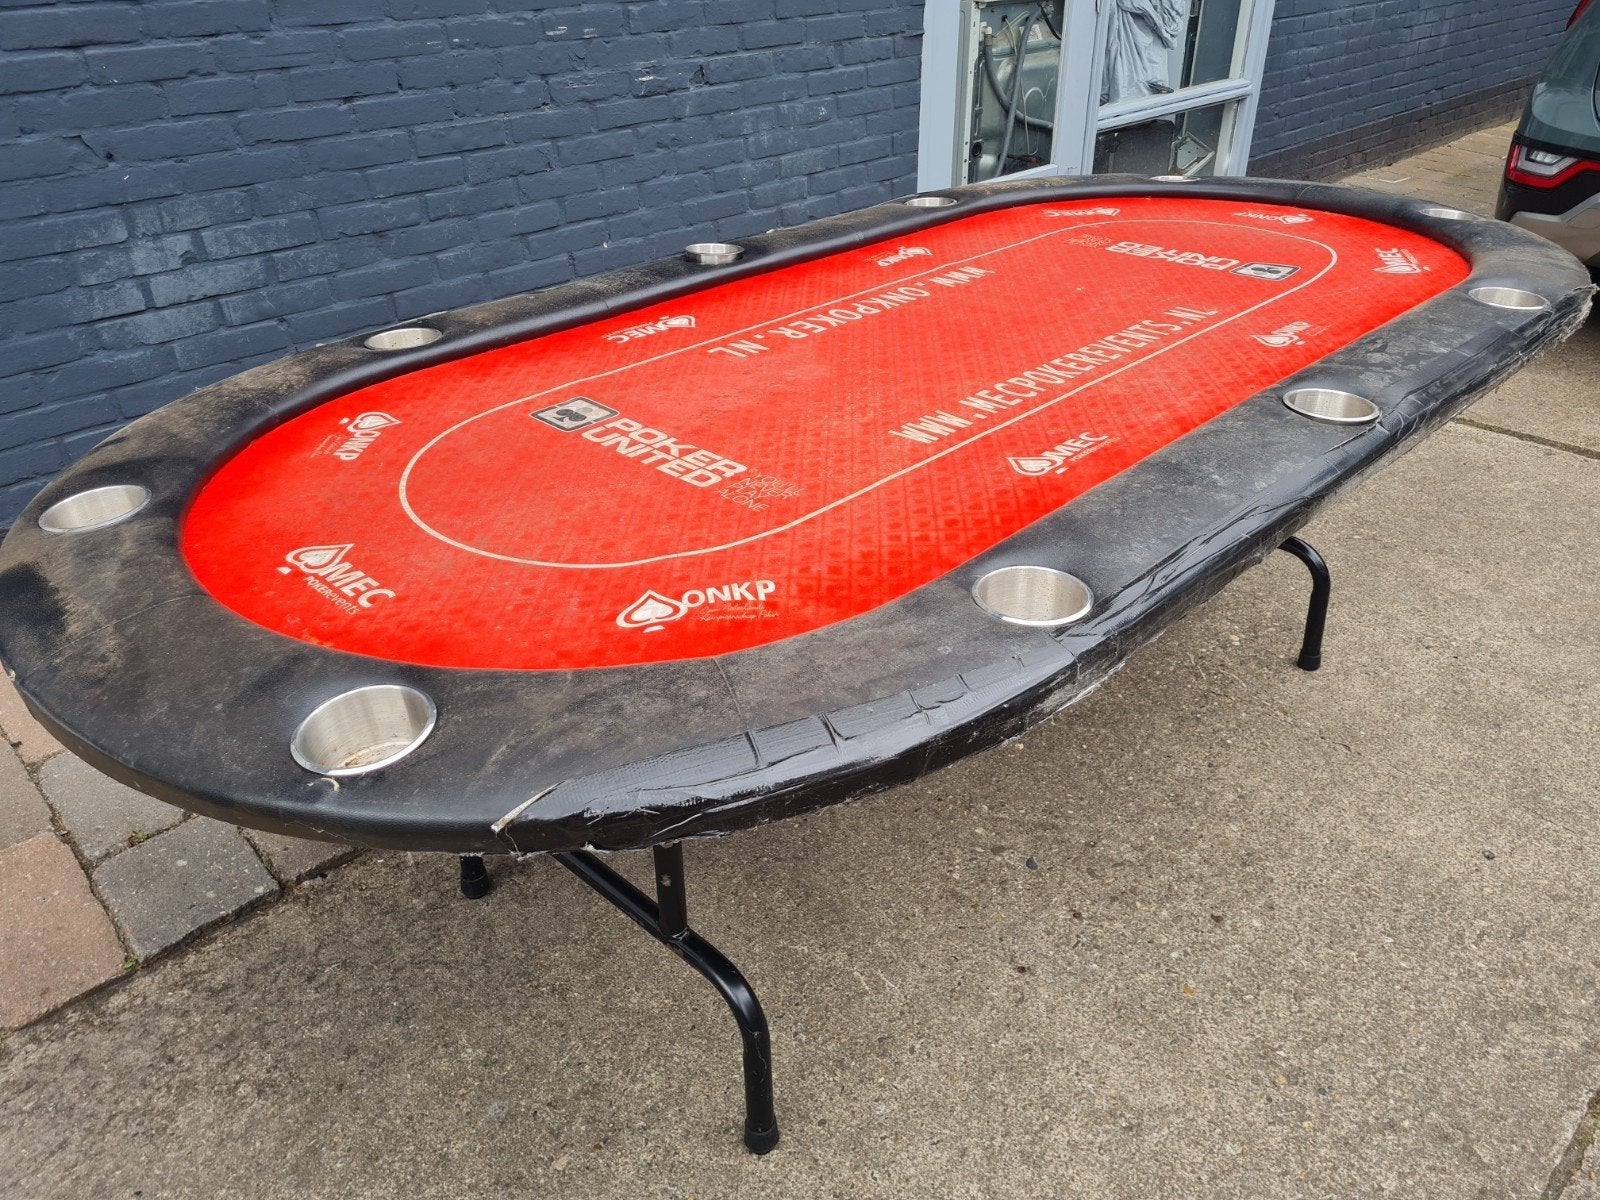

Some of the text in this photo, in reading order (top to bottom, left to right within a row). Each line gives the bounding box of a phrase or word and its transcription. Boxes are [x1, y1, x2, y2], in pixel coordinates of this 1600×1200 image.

[1374, 247, 1408, 264] MEC
[606, 324, 669, 344] MEC
[332, 431, 381, 461] ONKP
[581, 426, 723, 488] UNITED
[605, 418, 748, 478] POKER
[1040, 431, 1109, 460] MEC
[317, 561, 396, 608] MEC
[681, 579, 776, 608] ONKP
